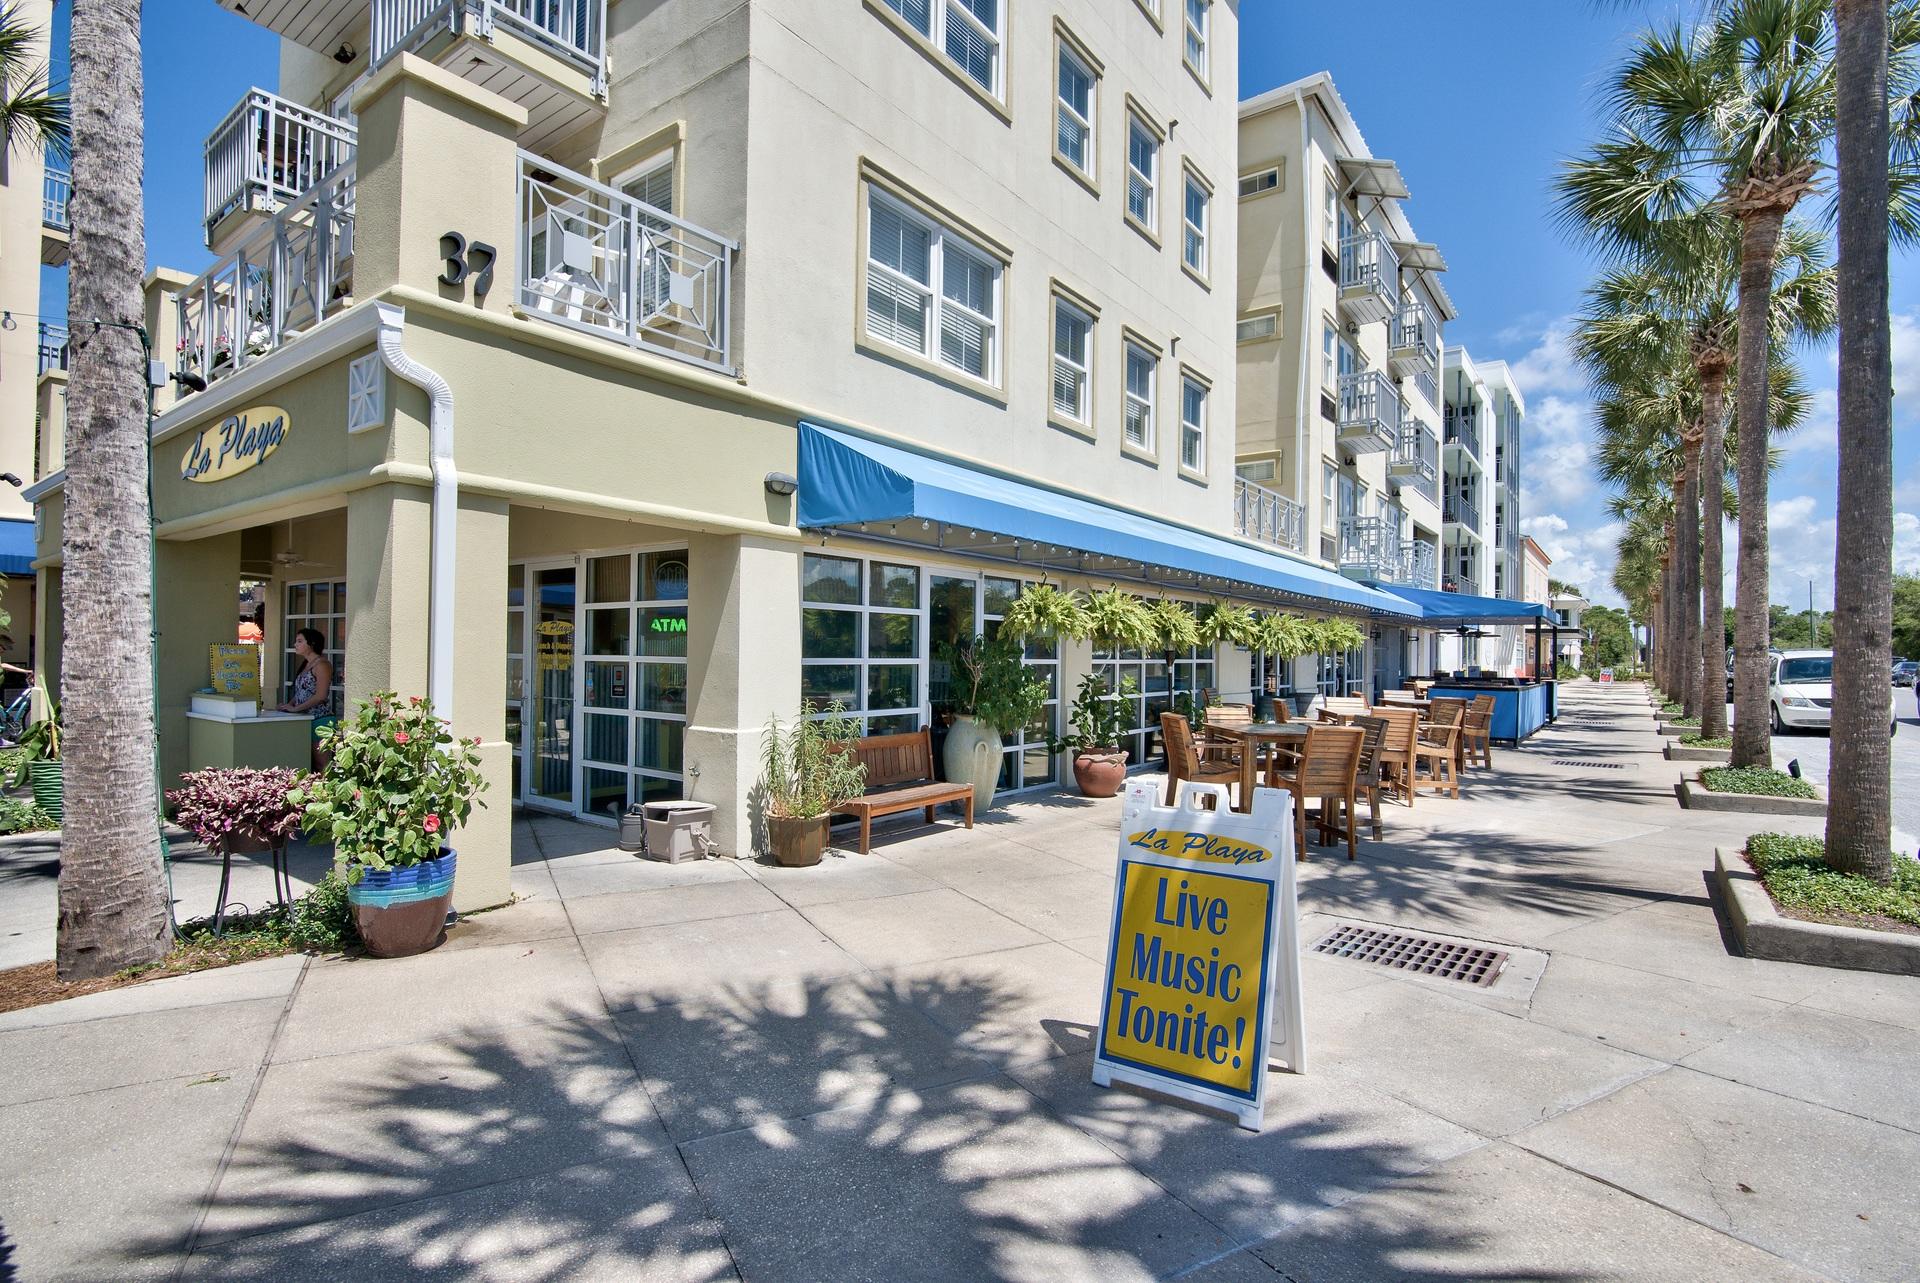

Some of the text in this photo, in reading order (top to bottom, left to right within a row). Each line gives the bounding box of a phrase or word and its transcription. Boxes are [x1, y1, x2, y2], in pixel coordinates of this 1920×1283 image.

[437, 231, 497, 297] 37
[182, 414, 286, 481] La Playa
[536, 621, 574, 636] La Playa
[650, 618, 687, 633] ATM
[1130, 828, 1267, 866] La Playa
[1154, 877, 1229, 936] Live
[1130, 933, 1242, 1003] Music
[1116, 987, 1247, 1070] Tonite!
